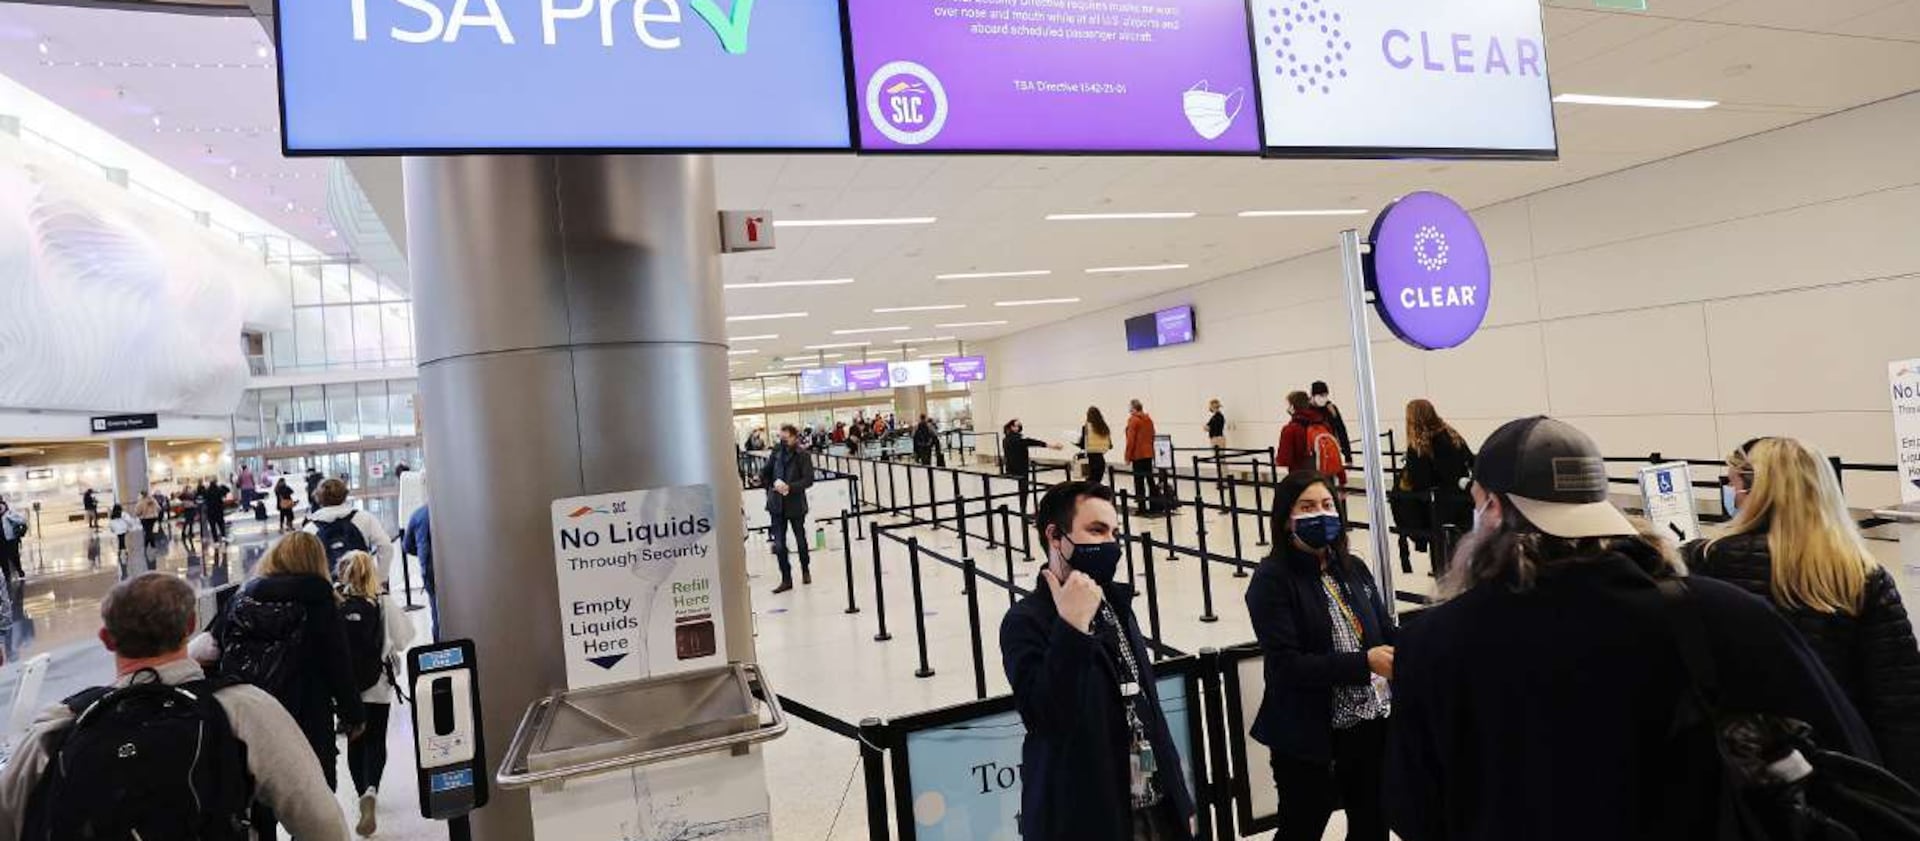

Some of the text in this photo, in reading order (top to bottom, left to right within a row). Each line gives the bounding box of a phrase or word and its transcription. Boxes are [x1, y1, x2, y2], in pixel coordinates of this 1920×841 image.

[542, 0, 682, 50] Pre
[934, 6, 960, 17] over
[961, 7, 987, 18] nose
[989, 8, 1009, 20] and
[1011, 9, 1045, 21] mouth
[1161, 19, 1180, 30] and
[970, 22, 1008, 34] aboard
[1010, 24, 1064, 37] scheduled
[1065, 28, 1117, 42] passenger
[1381, 28, 1541, 77] CLEAR
[1036, 80, 1079, 93] Directive
[890, 96, 924, 124] SLC
[1400, 285, 1475, 309] CLEAR
[1893, 382, 1913, 400] No
[612, 501, 627, 514] SLC
[560, 514, 712, 550] No Liquids
[568, 543, 709, 571] Through Security
[672, 578, 709, 594] Refill
[573, 596, 632, 616] Empty
[673, 594, 710, 608] Here
[570, 615, 639, 637] Liquids
[583, 637, 629, 655] Here
